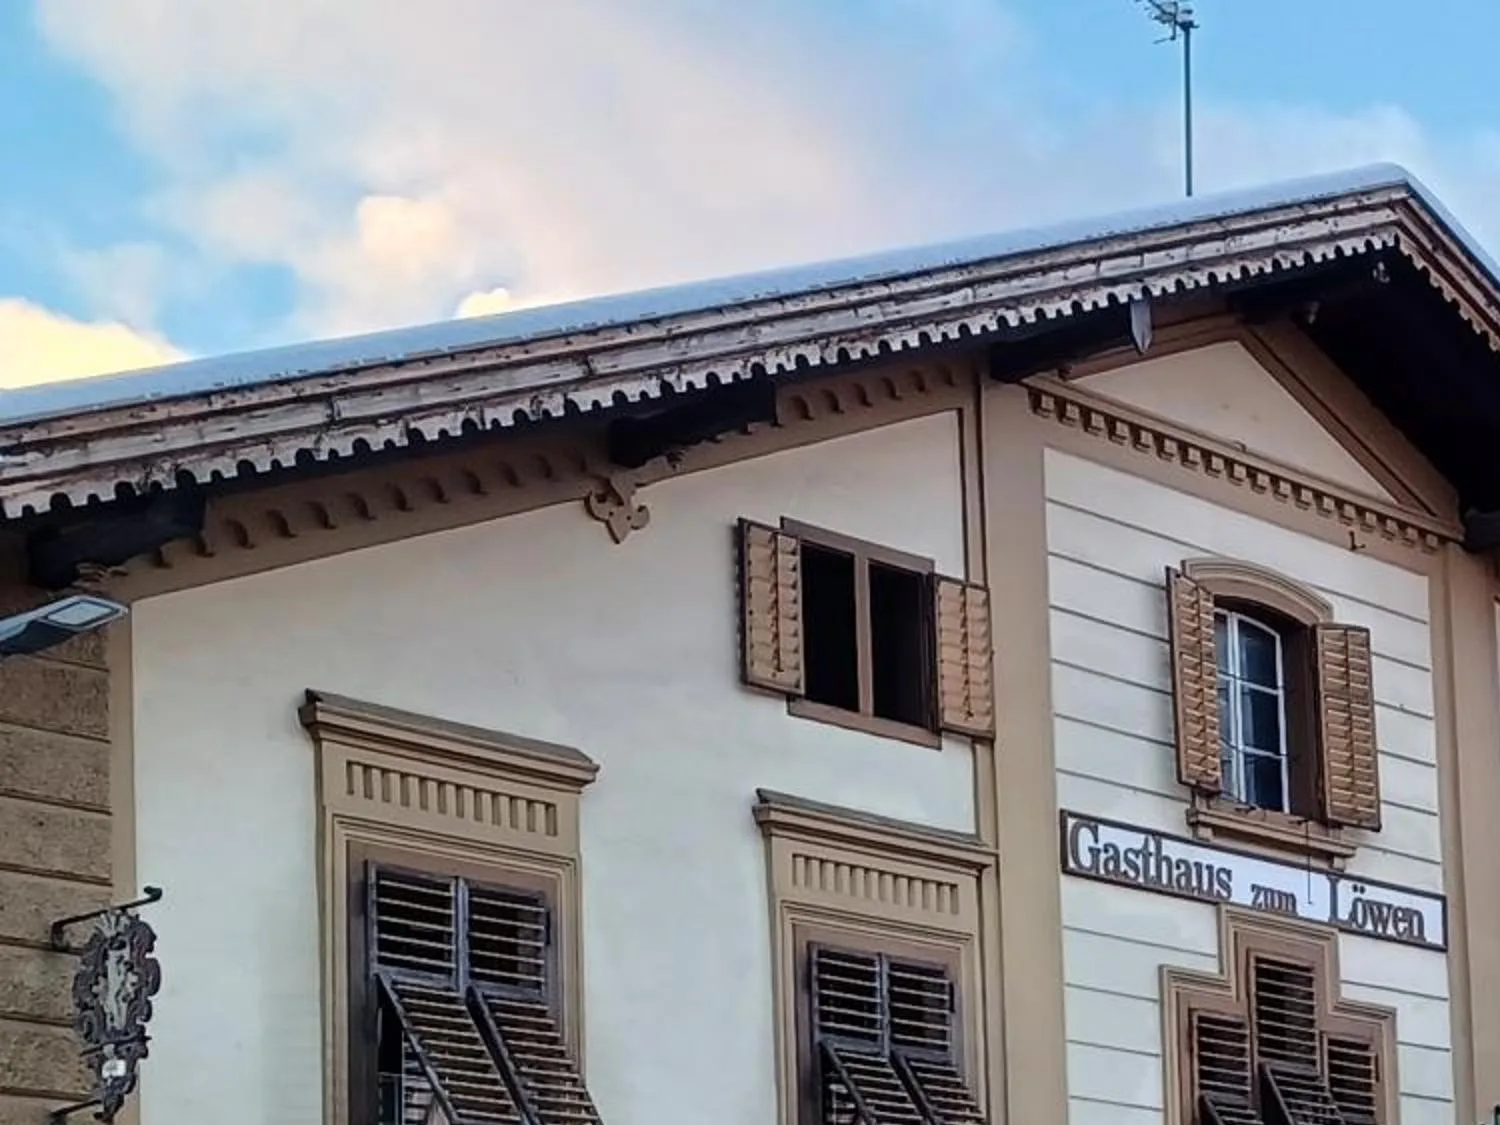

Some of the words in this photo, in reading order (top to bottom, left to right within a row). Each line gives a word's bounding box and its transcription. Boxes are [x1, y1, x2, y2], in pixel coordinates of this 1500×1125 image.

[1069, 820, 1233, 900] Gasthaus
[1250, 882, 1297, 914] zum
[1327, 873, 1427, 942] Löwen
